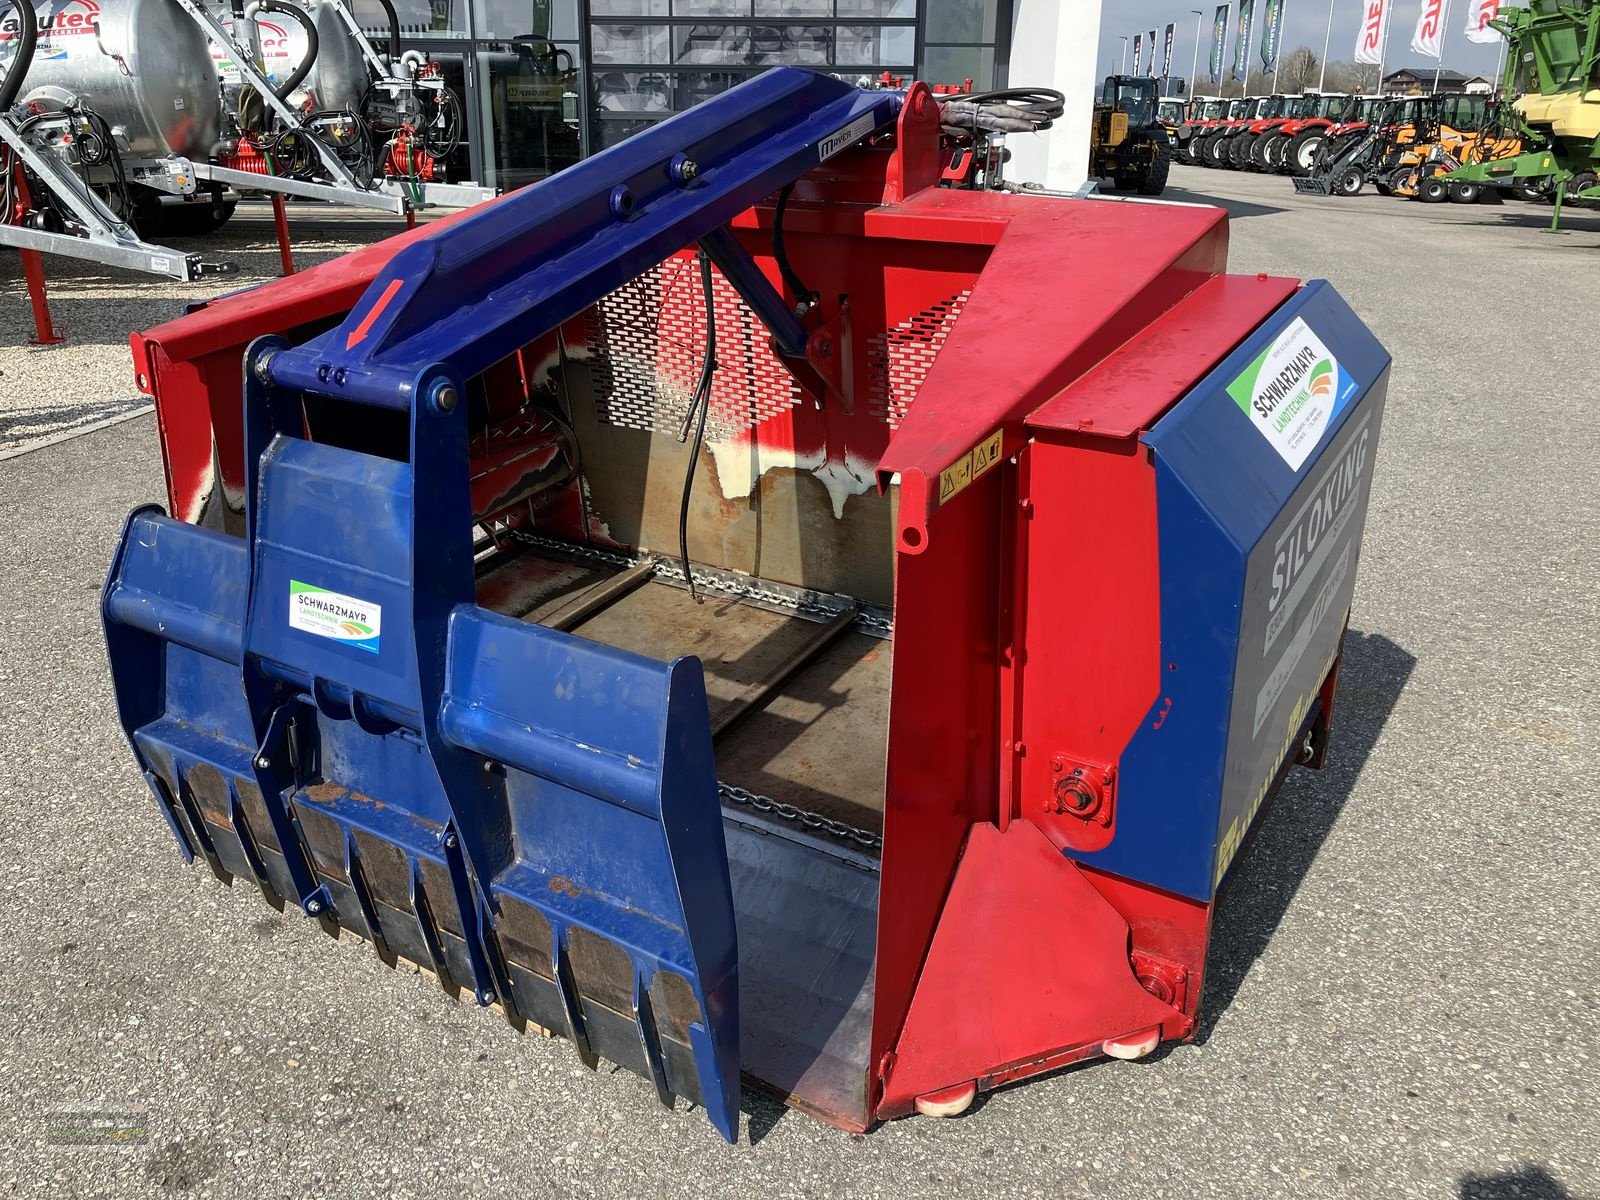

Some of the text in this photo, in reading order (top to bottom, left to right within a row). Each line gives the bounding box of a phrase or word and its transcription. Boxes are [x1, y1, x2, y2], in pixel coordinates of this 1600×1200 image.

[1253, 345, 1318, 418] SCHWARZMAYR
[1272, 387, 1312, 433] LANDTECHNIK
[1269, 428, 1369, 612] SILOKING
[298, 594, 367, 623] SCHWARZMAYR
[299, 606, 339, 624] LANDTECHNIK
